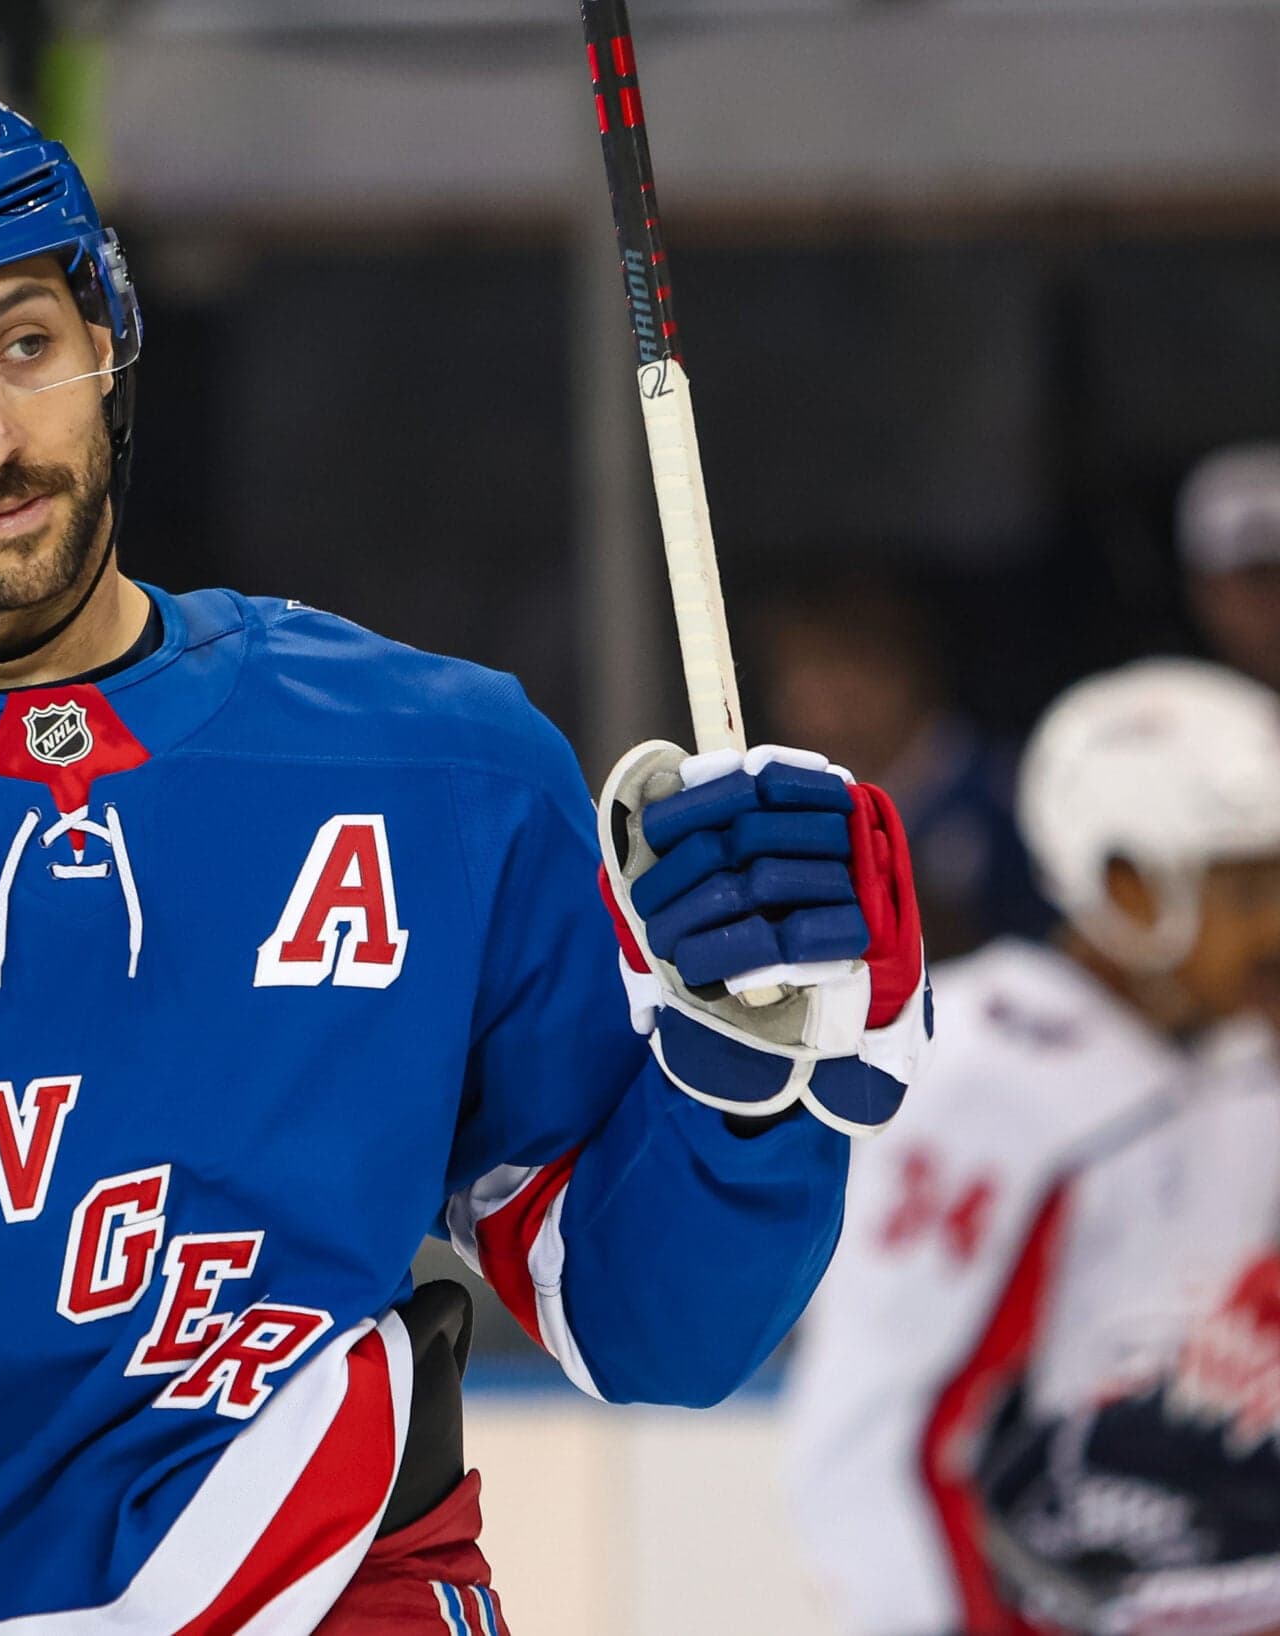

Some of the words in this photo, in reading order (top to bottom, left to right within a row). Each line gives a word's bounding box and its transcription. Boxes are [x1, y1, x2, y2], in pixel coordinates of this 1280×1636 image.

[625, 249, 659, 363] RRIOR
[41, 718, 76, 754] NHL
[252, 813, 409, 989] A
